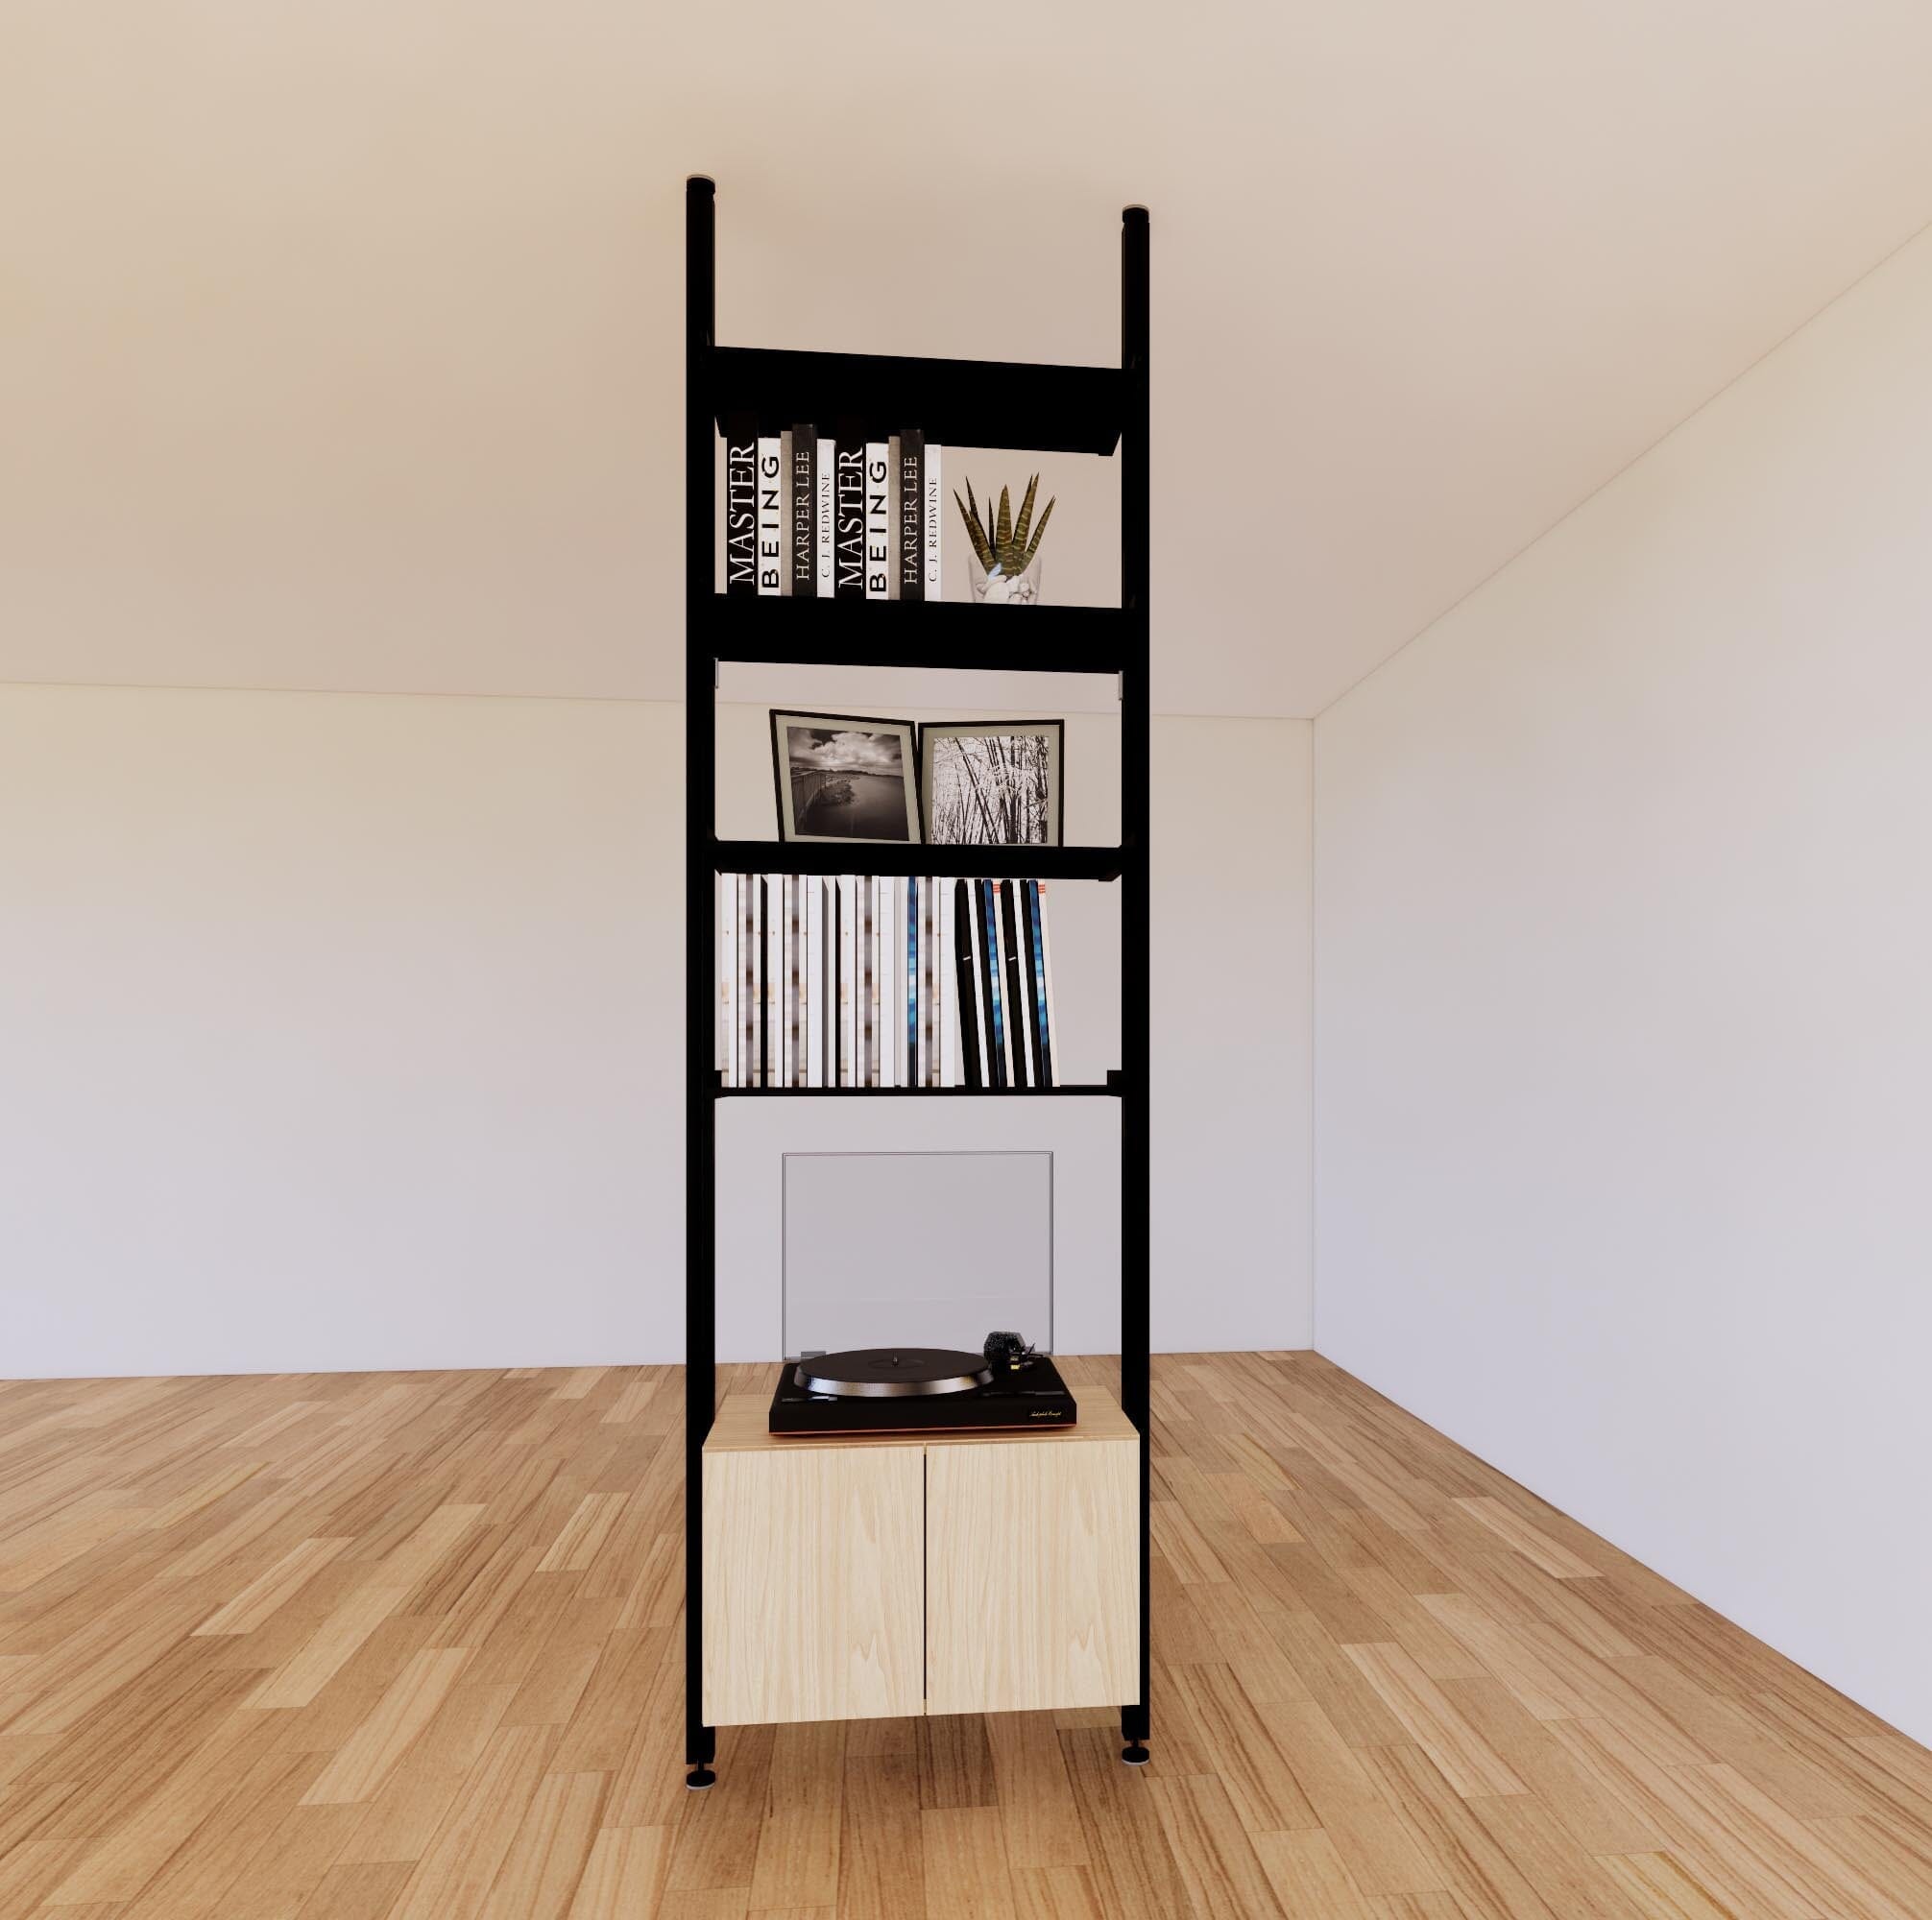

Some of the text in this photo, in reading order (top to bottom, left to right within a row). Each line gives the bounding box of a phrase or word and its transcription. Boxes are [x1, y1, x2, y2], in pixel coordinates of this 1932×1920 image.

[729, 443, 755, 586] MASTER
[761, 456, 779, 588] BEING
[796, 451, 810, 580] HARPER LEE
[821, 472, 831, 543] REDWINE
[837, 446, 863, 589] MASTER
[869, 462, 886, 591] BEING
[904, 456, 918, 584] HARPER LEE
[929, 477, 937, 548] REDWINE
